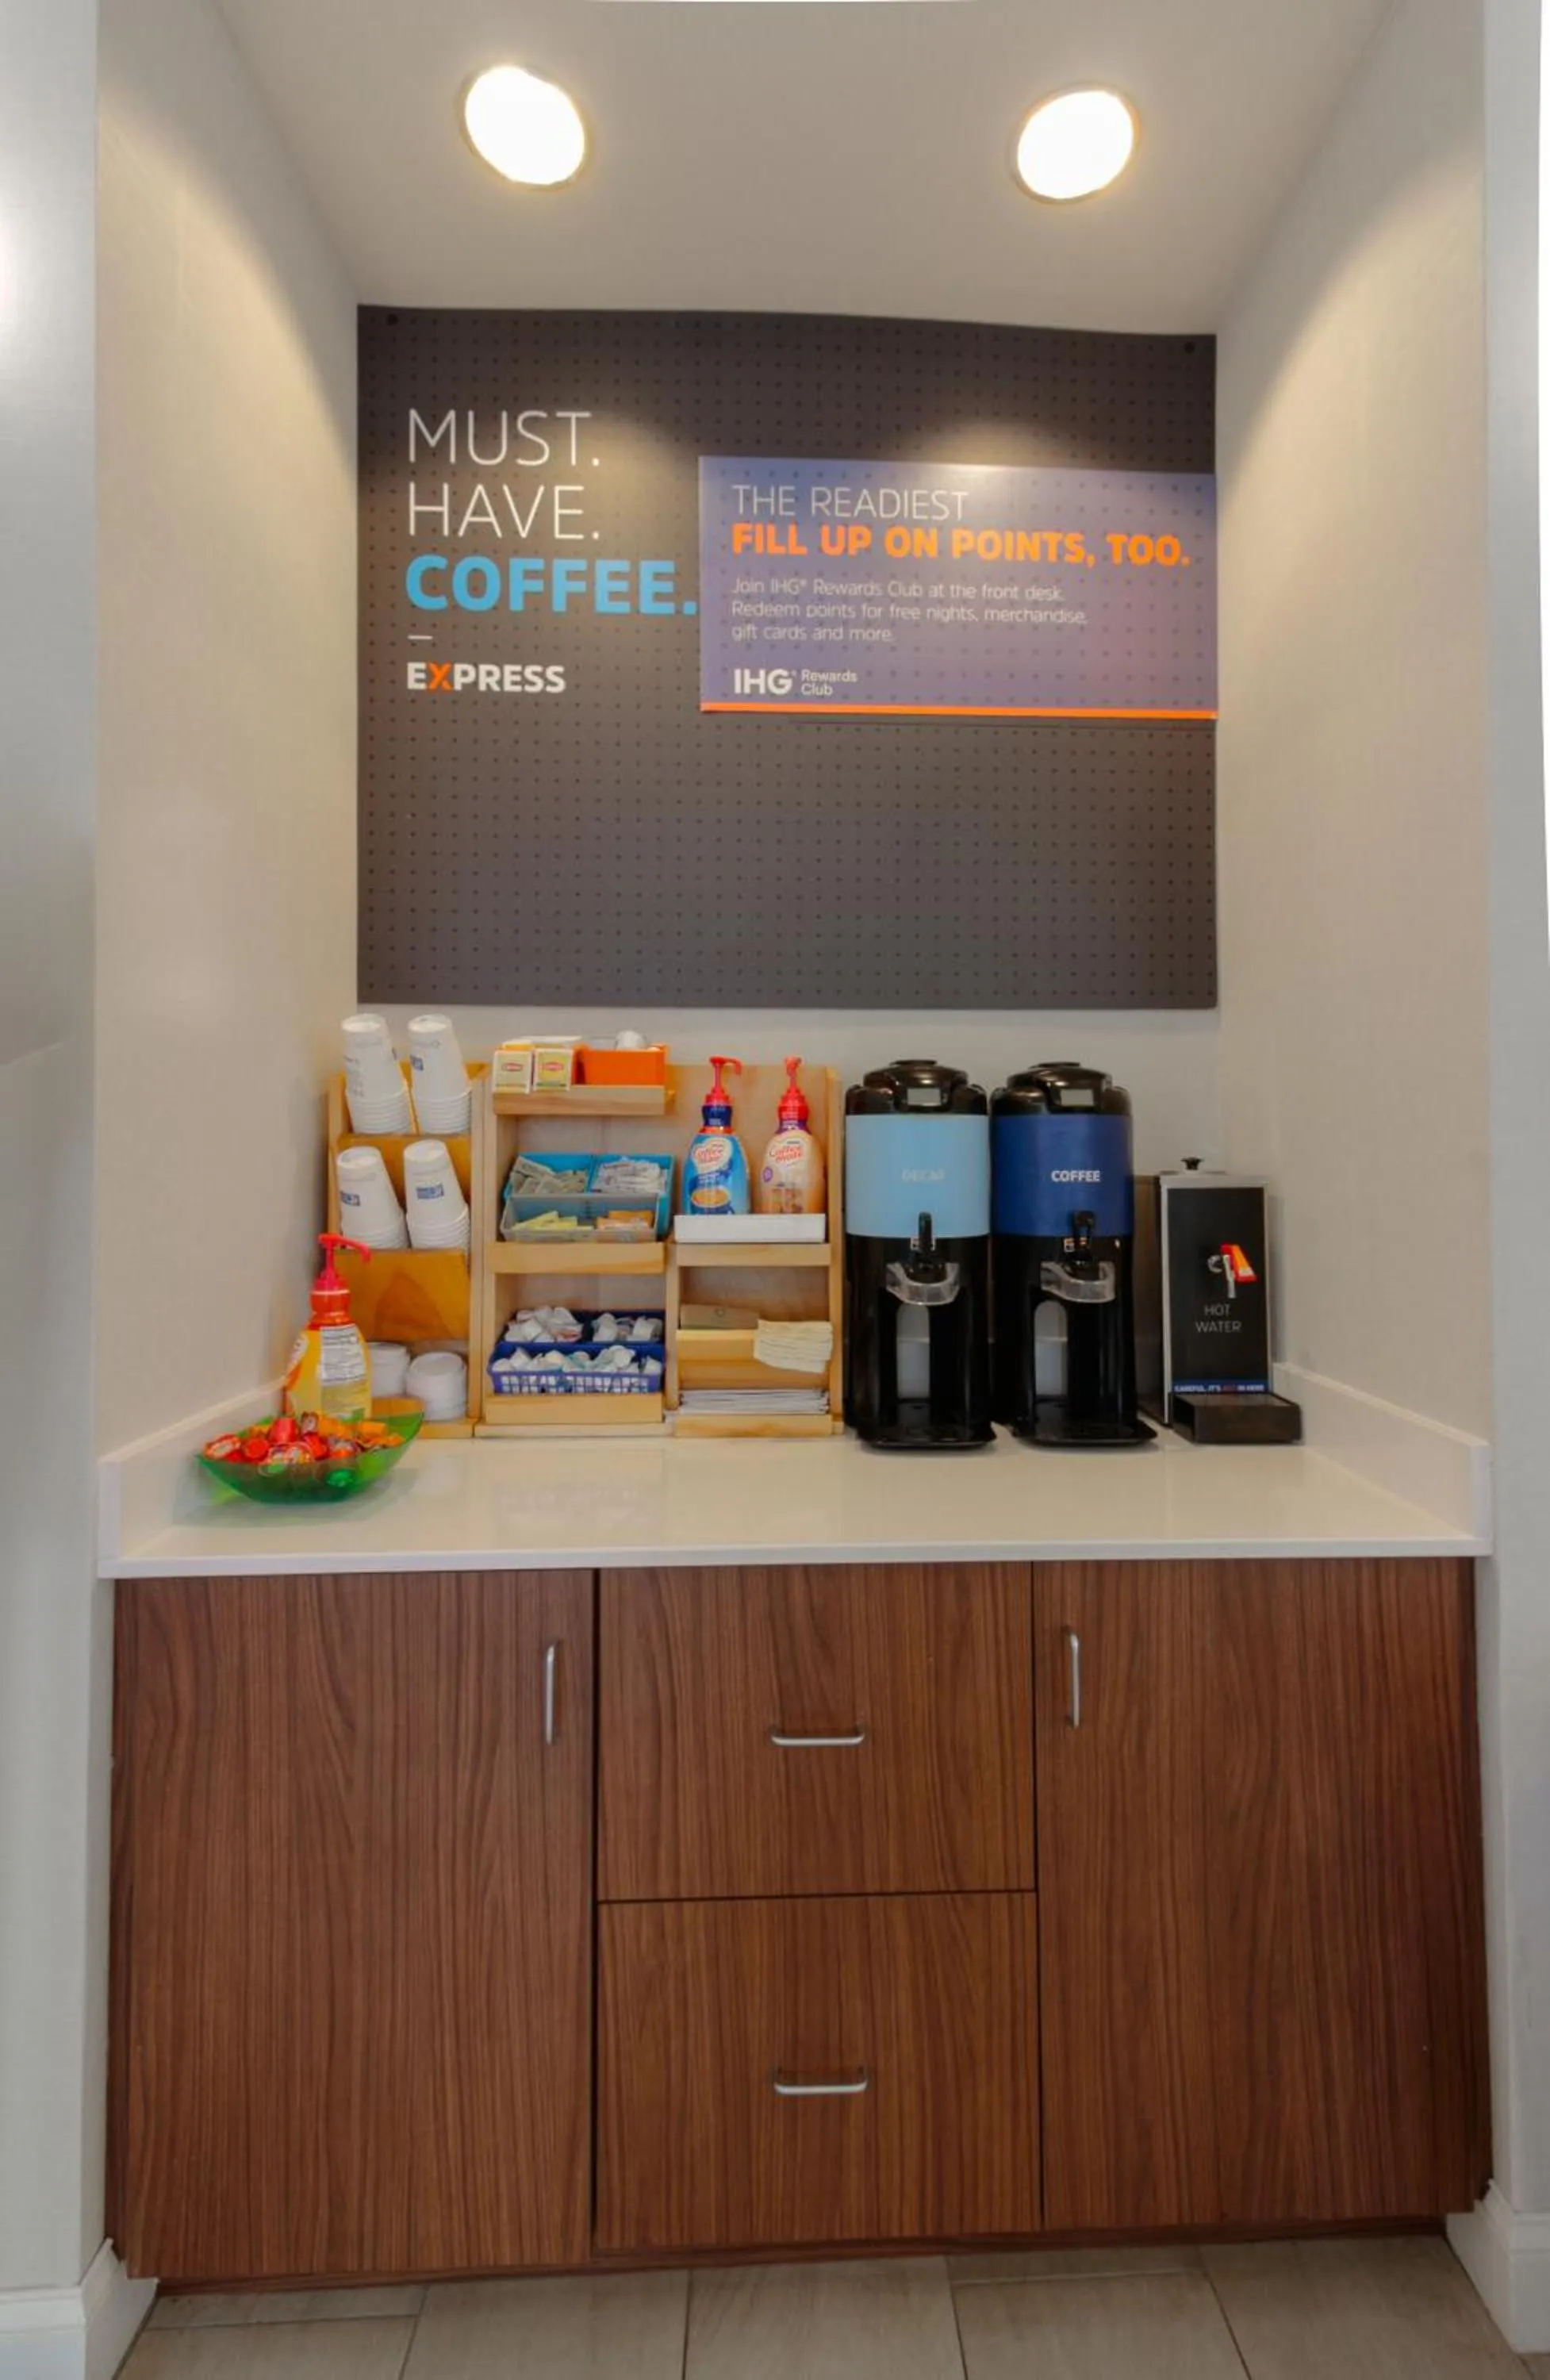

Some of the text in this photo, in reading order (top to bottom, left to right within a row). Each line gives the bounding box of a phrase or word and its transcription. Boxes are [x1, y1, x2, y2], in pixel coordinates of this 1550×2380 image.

[409, 408, 600, 466] MUST.
[409, 481, 600, 540] HAVE.
[731, 485, 969, 521] THE READIEST
[731, 521, 1190, 569] FILL UP ON POINTS, TOO.
[405, 553, 698, 616] COFFEE.
[731, 578, 765, 594] Join
[812, 578, 883, 596] Rewards
[887, 580, 923, 597] Club
[928, 583, 945, 598] at
[950, 583, 977, 599] the
[981, 583, 1019, 600] front
[731, 601, 801, 617] Redeem
[805, 602, 857, 620] points
[861, 602, 883, 619] for
[888, 603, 922, 620] free
[731, 624, 758, 642] gift
[762, 625, 808, 641] cards
[812, 626, 844, 641] and
[406, 661, 566, 693] EXPRESS
[800, 669, 858, 684] Rewards
[800, 682, 834, 697] Club
[1051, 1169, 1101, 1183] COFFEE
[1203, 1303, 1230, 1317] HOT
[1195, 1319, 1243, 1334] WATER
